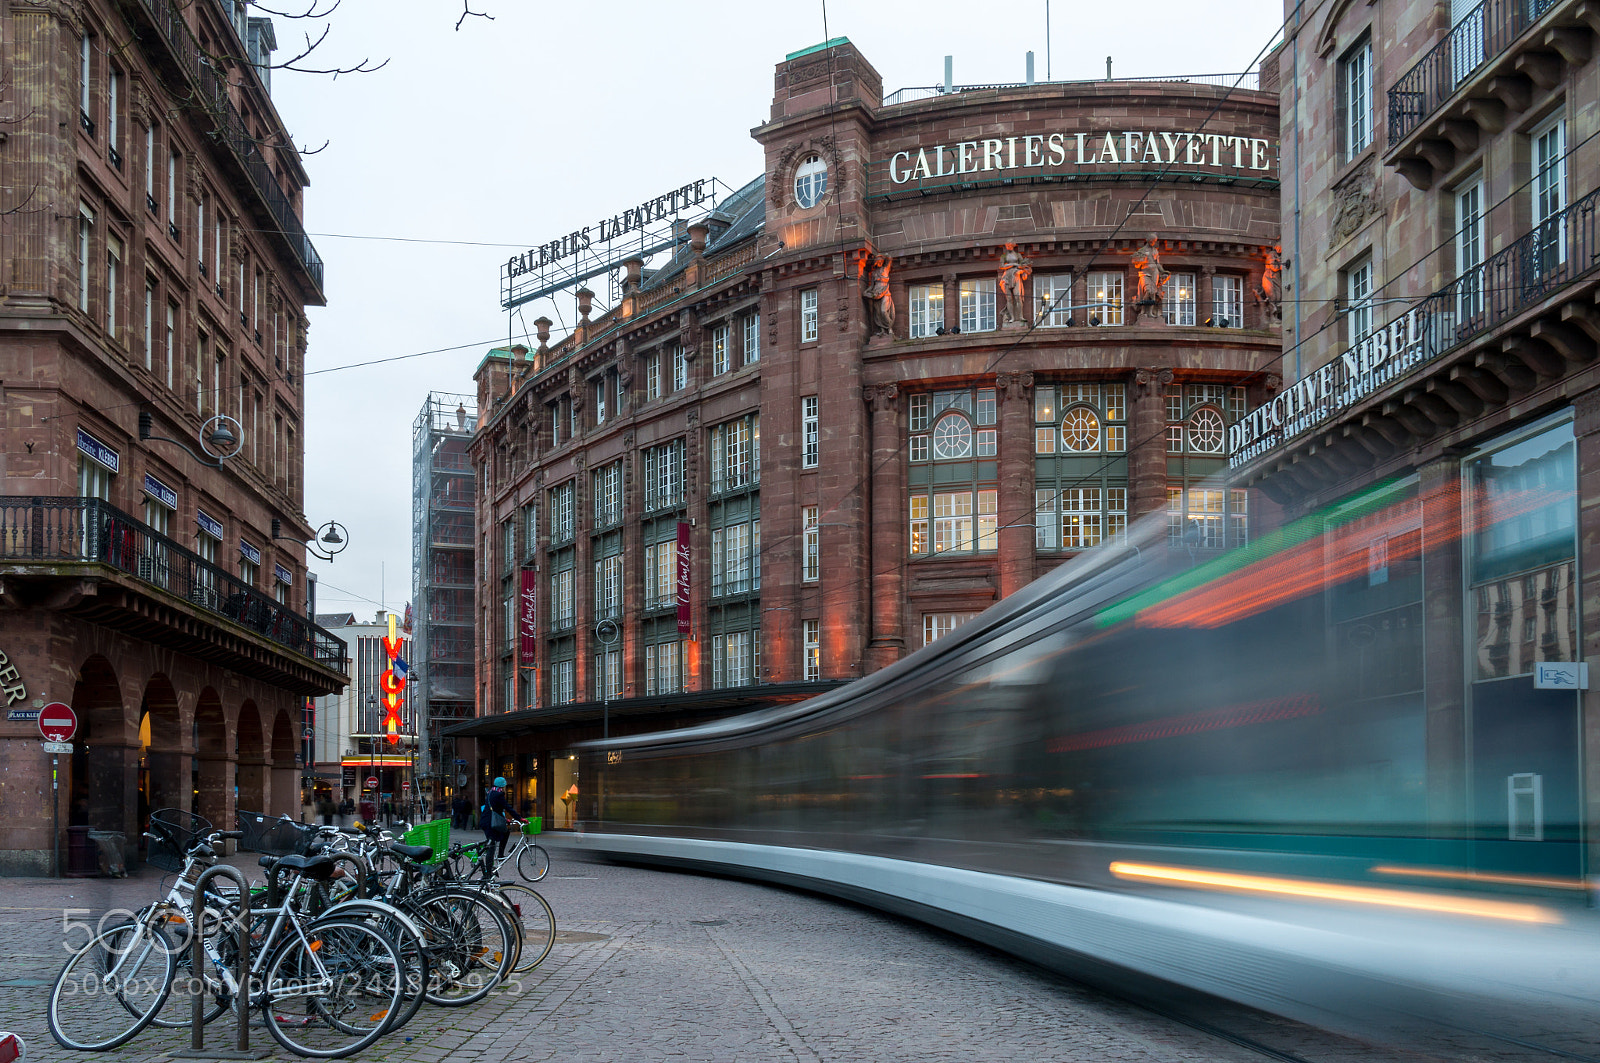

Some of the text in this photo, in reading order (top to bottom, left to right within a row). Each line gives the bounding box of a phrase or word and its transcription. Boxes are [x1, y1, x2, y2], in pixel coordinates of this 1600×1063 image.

[889, 131, 1271, 184] GALERIES LAFAYETTE
[507, 178, 706, 279] GALERIES LAFAYETTE
[1229, 310, 1425, 455] DETECTIVE NIBEL
[381, 637, 406, 726] VOX
